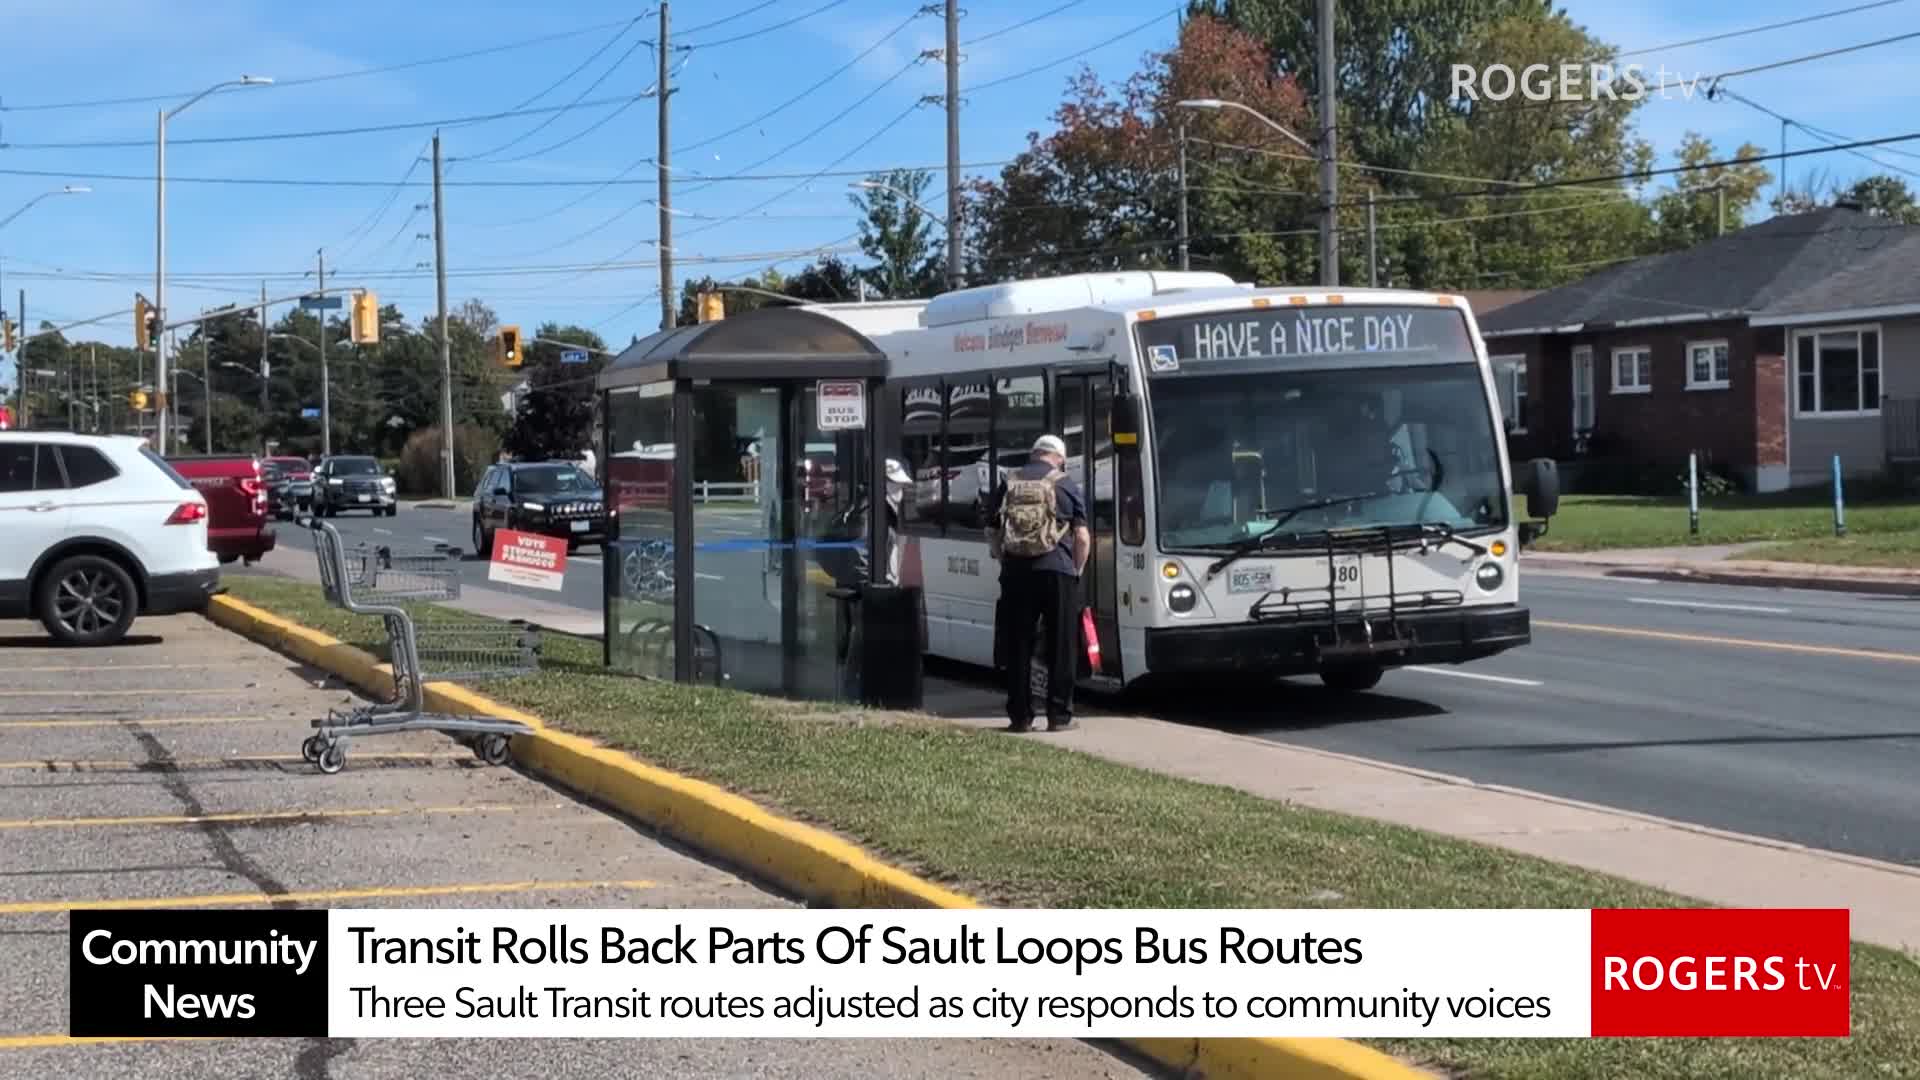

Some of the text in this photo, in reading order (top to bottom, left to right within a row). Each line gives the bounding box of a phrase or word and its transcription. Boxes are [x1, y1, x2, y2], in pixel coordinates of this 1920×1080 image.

[1195, 313, 1413, 360] HAVE A NICE DAY
[828, 407, 855, 415] BUS
[824, 415, 860, 424] STOP
[518, 536, 546, 549] VOTE
